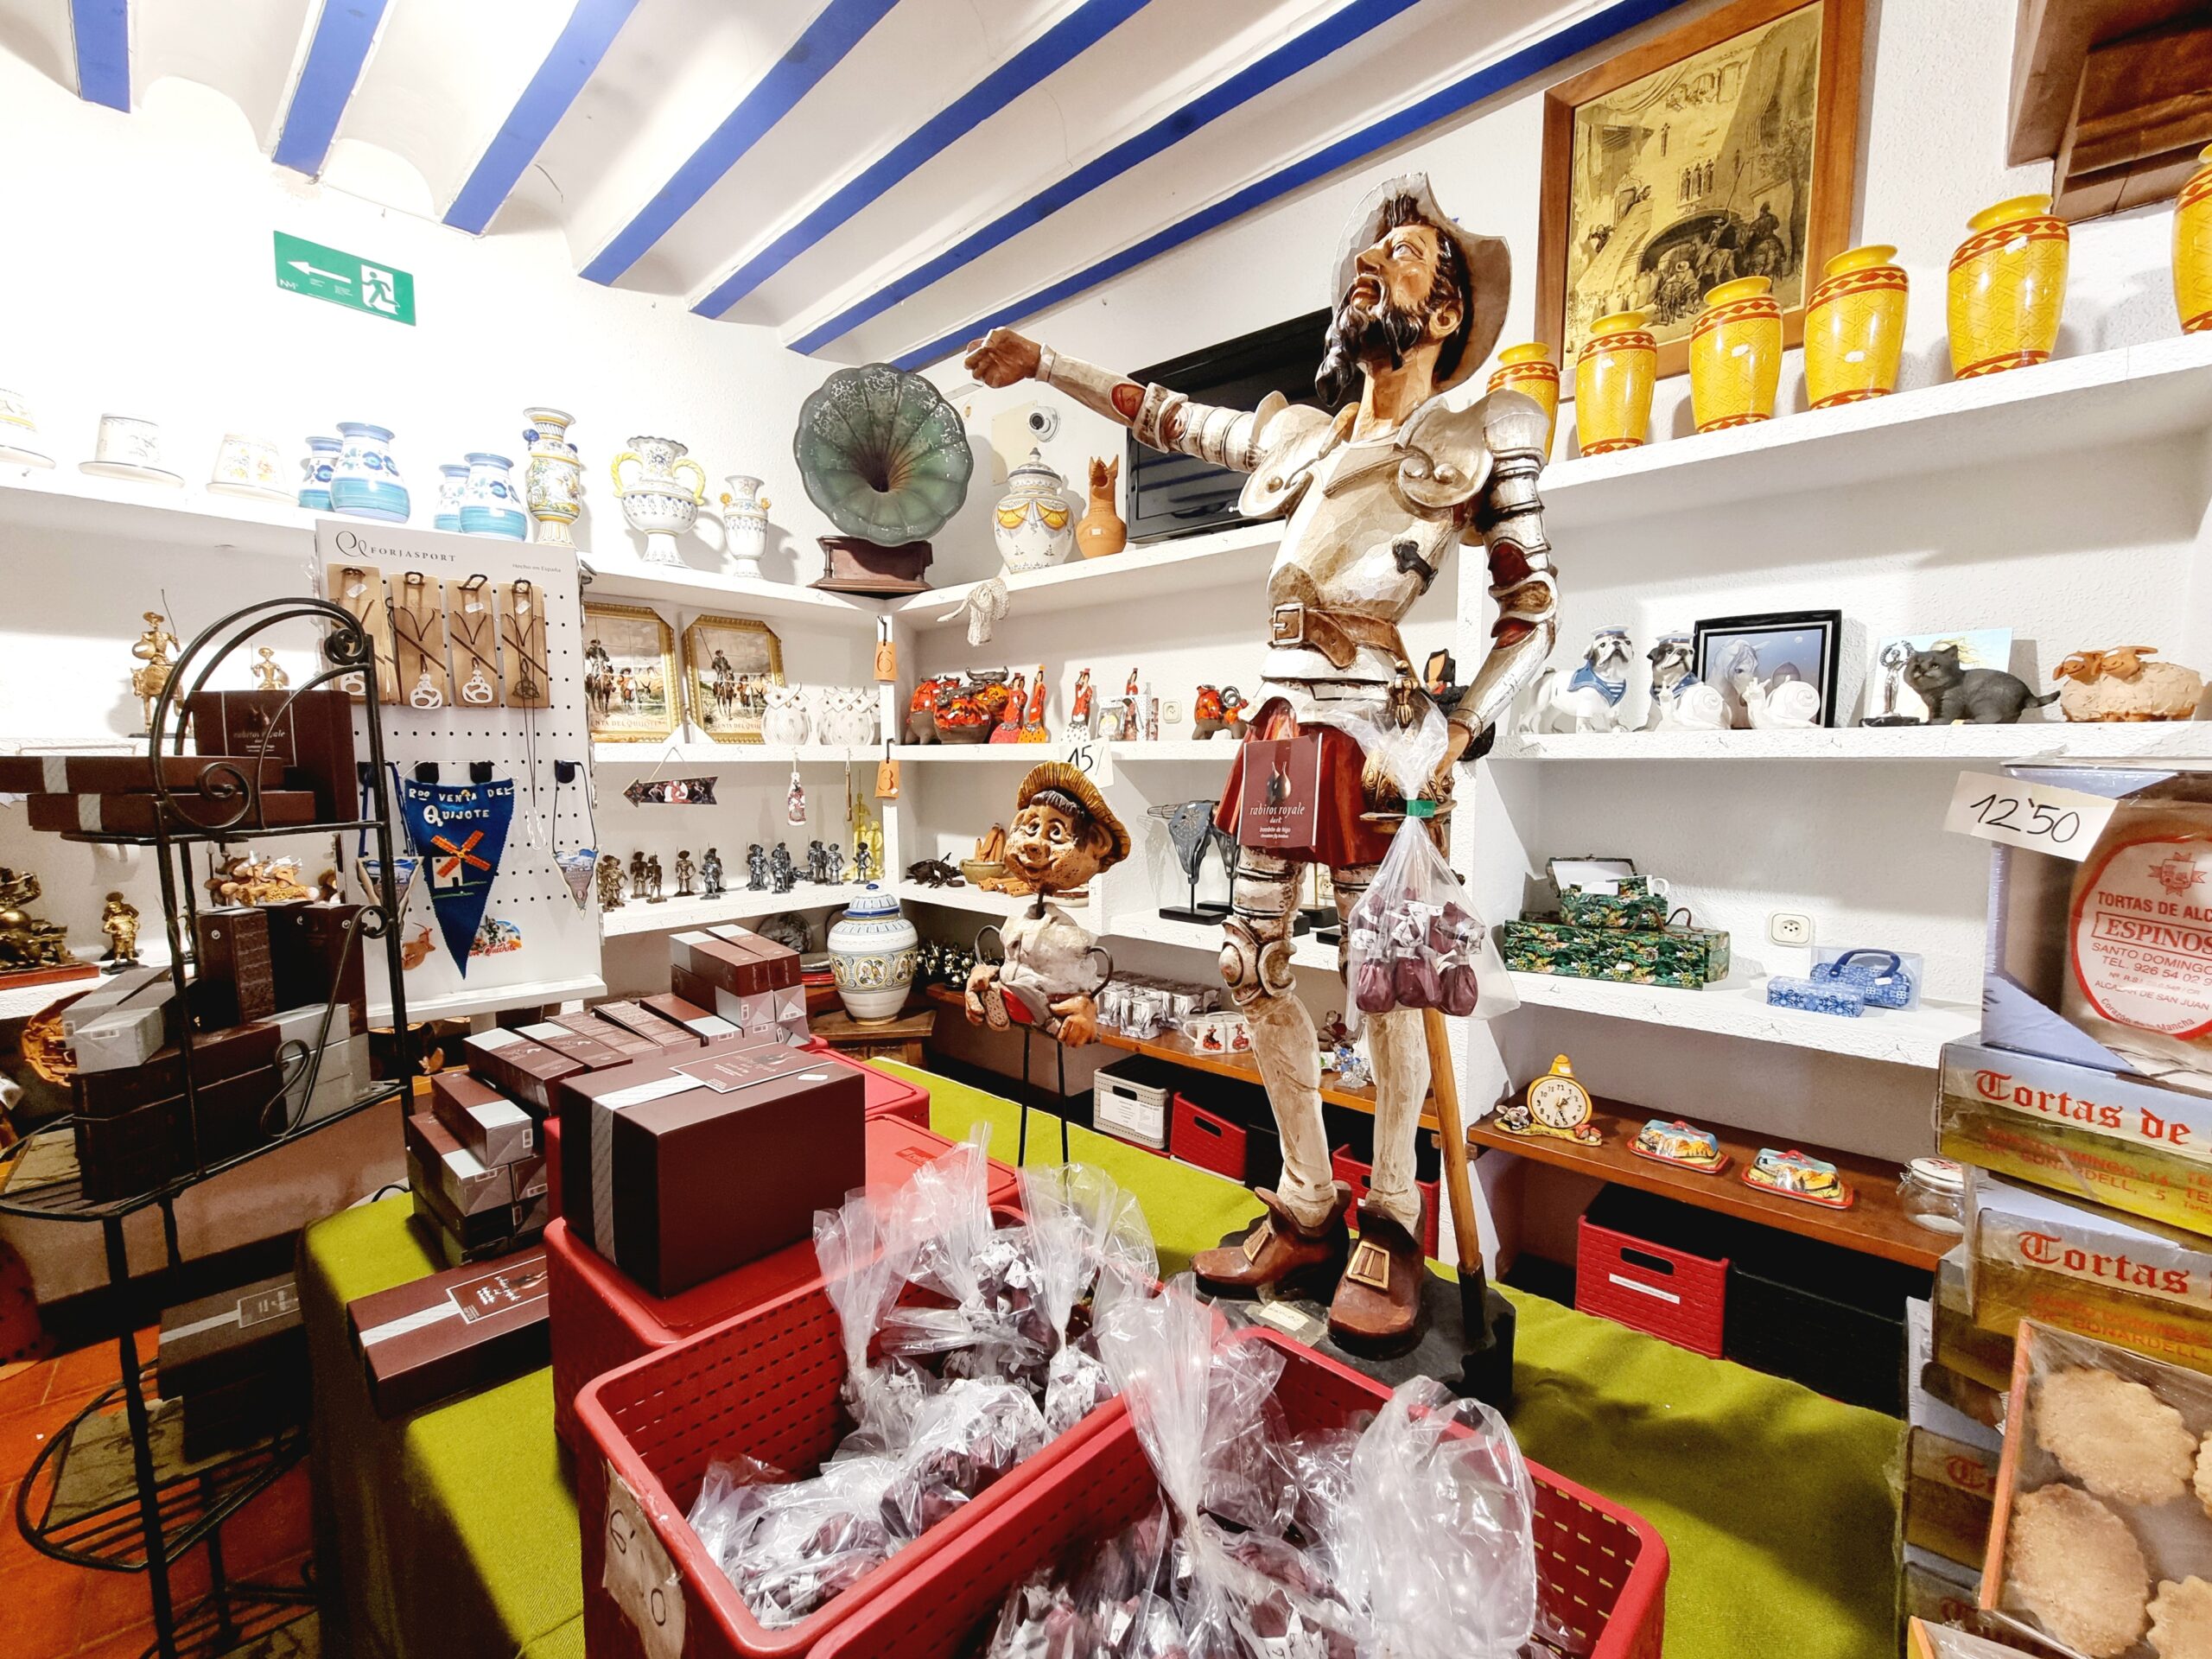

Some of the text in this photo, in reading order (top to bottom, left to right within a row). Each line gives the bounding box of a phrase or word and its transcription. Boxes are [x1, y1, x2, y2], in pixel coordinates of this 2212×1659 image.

[371, 547, 456, 562] FORJASPORT
[876, 650, 893, 673] 6
[878, 768, 894, 791] 3
[423, 805, 490, 827] QUIJOTE
[1249, 802, 1306, 818] rabitos royale
[1970, 794, 2080, 843] 12'50
[2098, 891, 2153, 912] TORTAS
[2158, 901, 2178, 916] DE
[2105, 918, 2212, 955] ESPINOS
[2092, 943, 2212, 975] SANTO DOMINGO
[2102, 956, 2129, 969] TEL.
[2133, 963, 2158, 976] 926
[2162, 969, 2178, 979] 54
[2183, 973, 2200, 984] 02
[2139, 990, 2154, 999] DE
[2157, 994, 2178, 1004] SAN
[2180, 1000, 2209, 1010] JUAN
[2157, 1018, 2195, 1031] Mancha
[1974, 1070, 2191, 1146] Tortas de
[2018, 1230, 2191, 1294] Tortas
